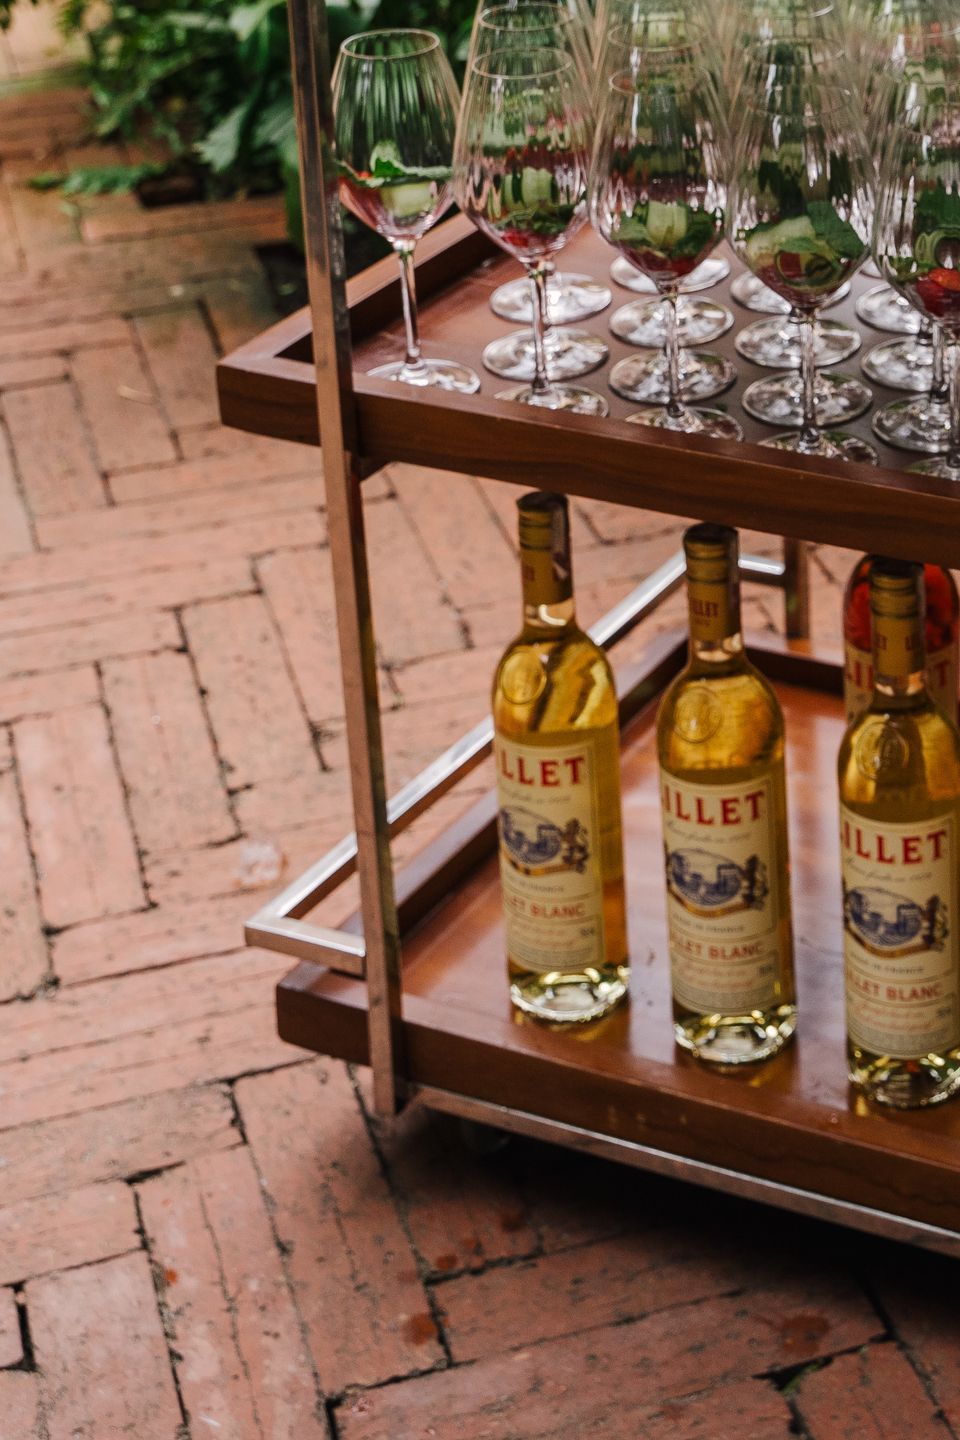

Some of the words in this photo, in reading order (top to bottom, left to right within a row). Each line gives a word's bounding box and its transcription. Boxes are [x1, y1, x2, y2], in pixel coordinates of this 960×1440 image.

[501, 748, 586, 787] LLET
[663, 784, 765, 826] ILLET
[843, 820, 947, 865] ILLET
